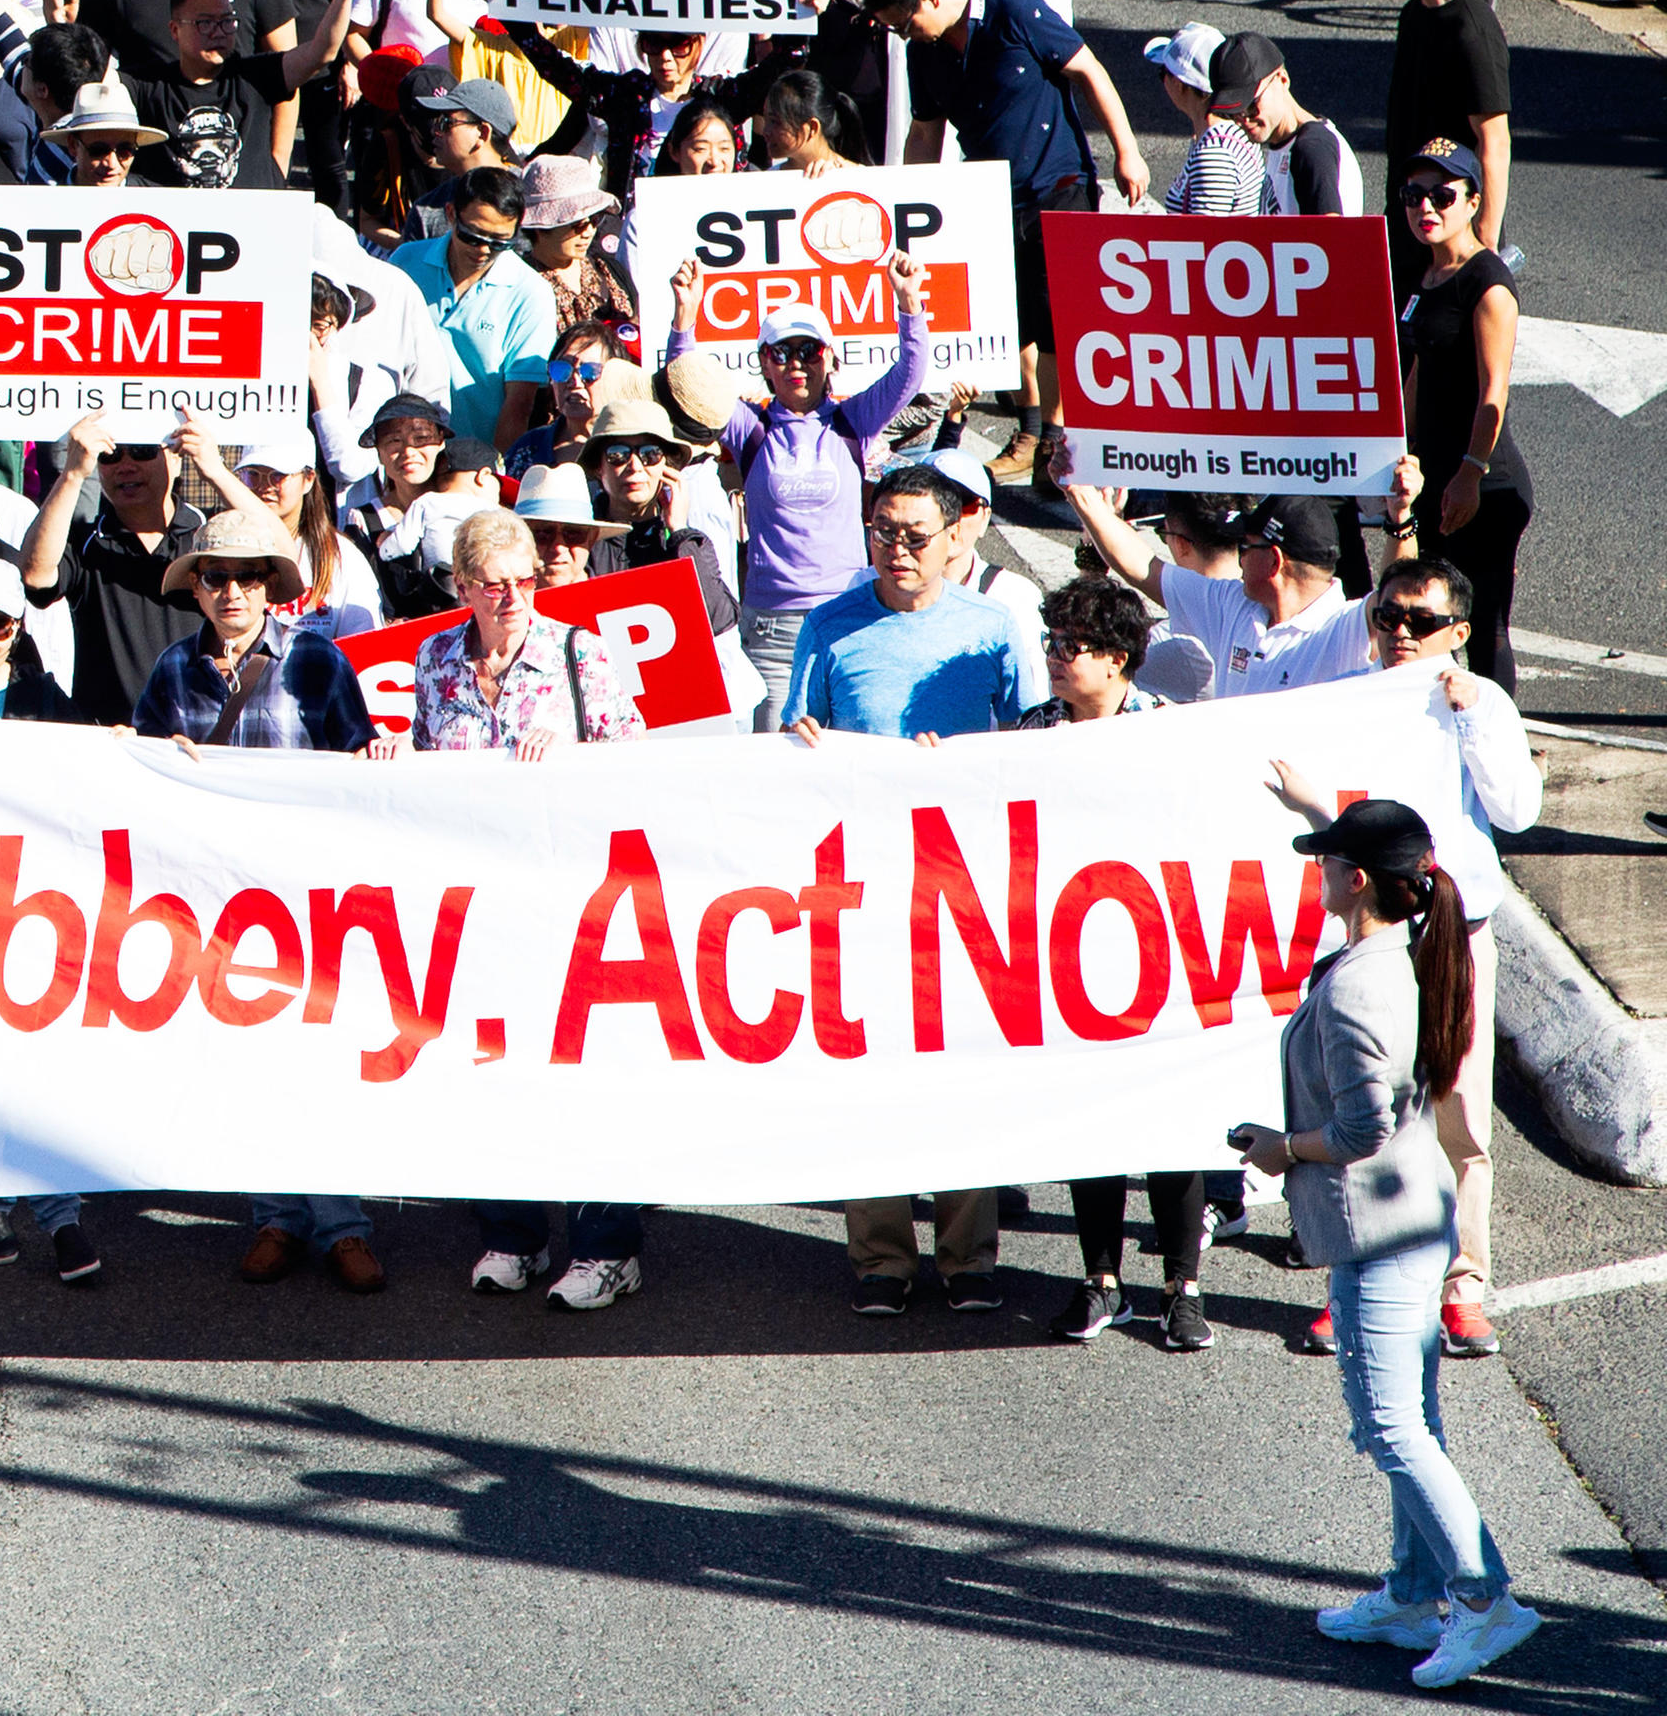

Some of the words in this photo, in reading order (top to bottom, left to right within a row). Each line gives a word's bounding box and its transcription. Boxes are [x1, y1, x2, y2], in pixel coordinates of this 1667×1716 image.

[1098, 238, 1330, 318] STOP
[76, 381, 105, 410] is
[121, 381, 298, 420] Enough!!!
[1074, 329, 1380, 412] CRIME!
[1101, 444, 1198, 479] Enough
[1206, 449, 1231, 474] is
[1240, 450, 1358, 483] Enough!
[547, 820, 869, 1064] Act
